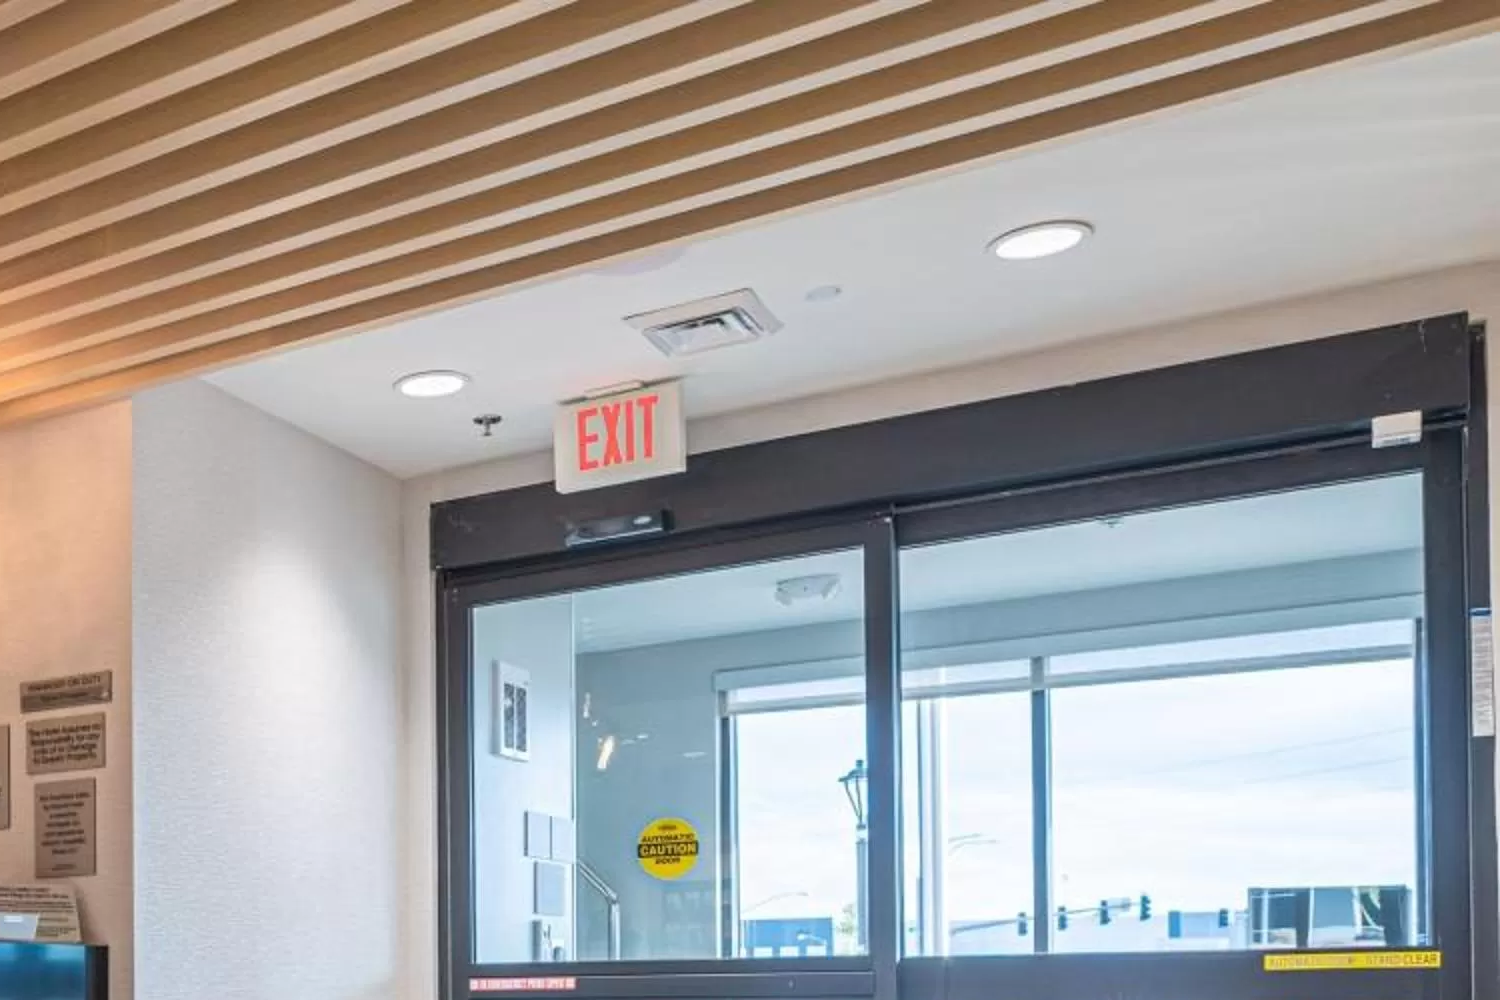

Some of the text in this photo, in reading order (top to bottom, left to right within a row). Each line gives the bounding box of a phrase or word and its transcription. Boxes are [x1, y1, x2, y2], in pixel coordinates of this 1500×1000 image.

[577, 395, 659, 471] EXIT
[641, 833, 696, 843] AUTOMATIC
[639, 843, 697, 857] CAUTION
[1402, 953, 1438, 965] CLEAR
